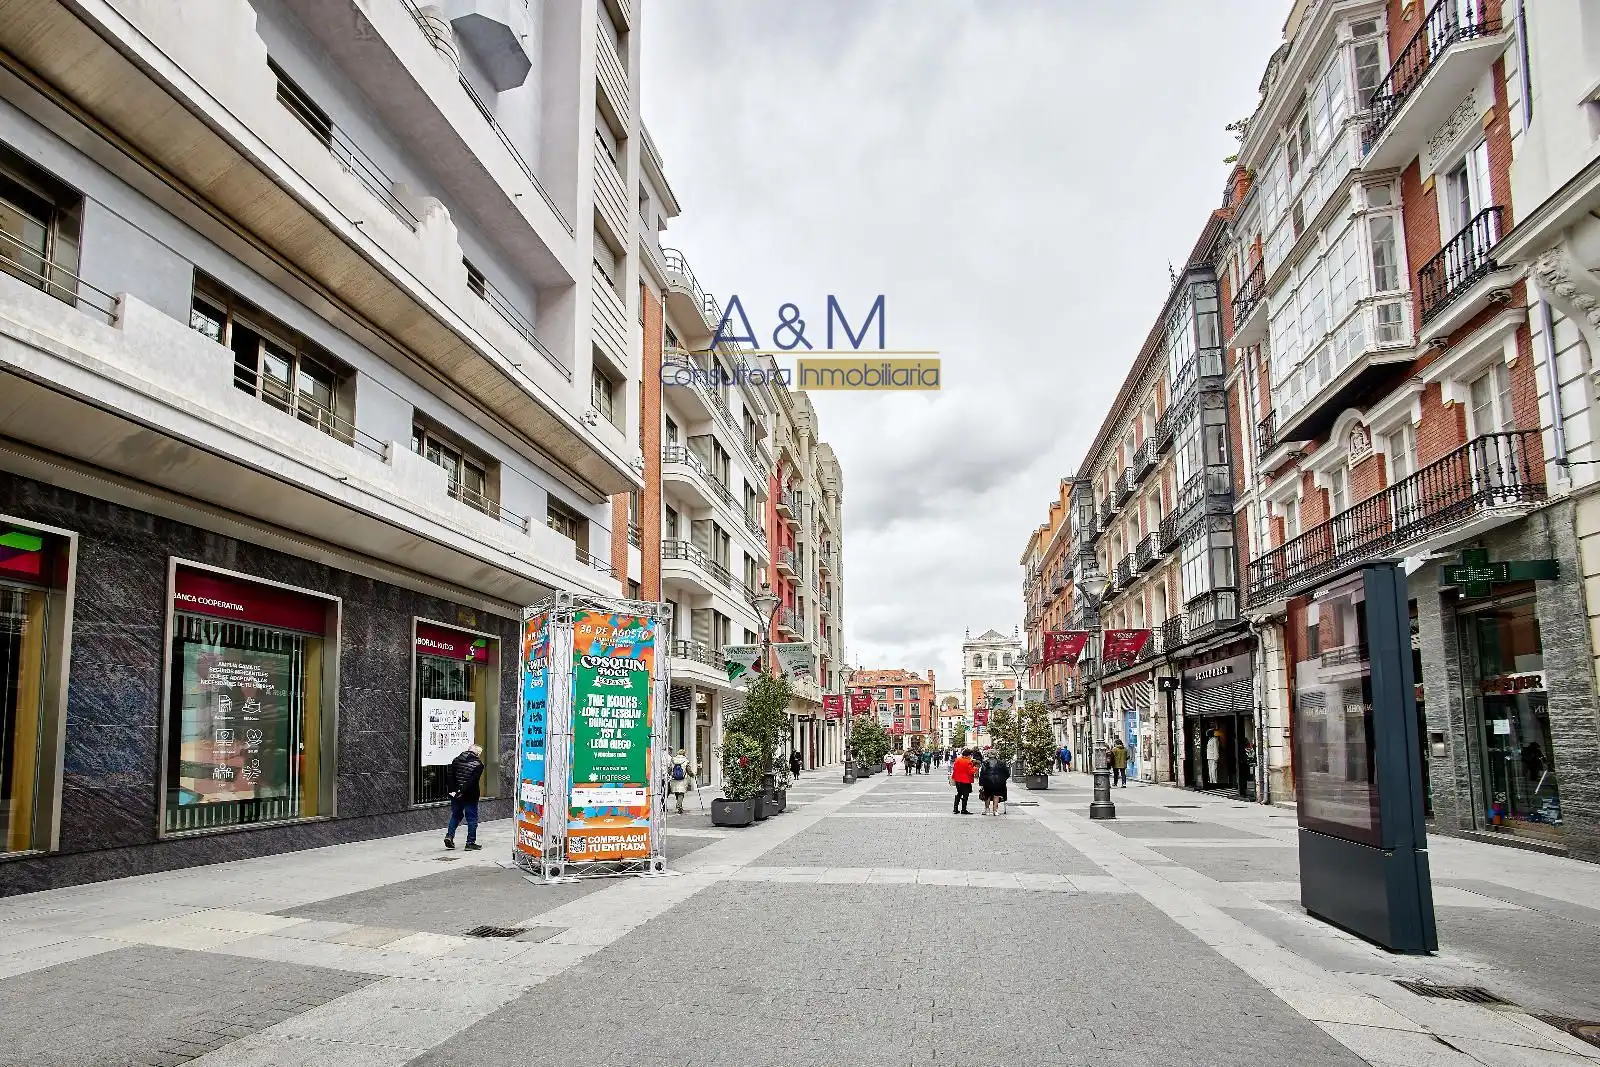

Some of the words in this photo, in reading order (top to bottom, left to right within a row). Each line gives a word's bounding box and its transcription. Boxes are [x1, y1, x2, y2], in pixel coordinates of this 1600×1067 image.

[197, 597, 244, 612] COOPERATIVA
[580, 624, 592, 634] 30
[596, 626, 609, 636] DE
[612, 627, 650, 641] AGOSTO
[437, 642, 454, 651] kutxa
[597, 667, 630, 677] ROCK
[587, 694, 605, 707] THE
[581, 707, 600, 717] LOVE
[600, 708, 611, 718] OF
[611, 708, 642, 719] LESBIAN
[599, 774, 631, 782] ingresse
[588, 835, 625, 844] COMPRA
[588, 844, 601, 853] TU
[601, 842, 647, 852] ENTRADA
